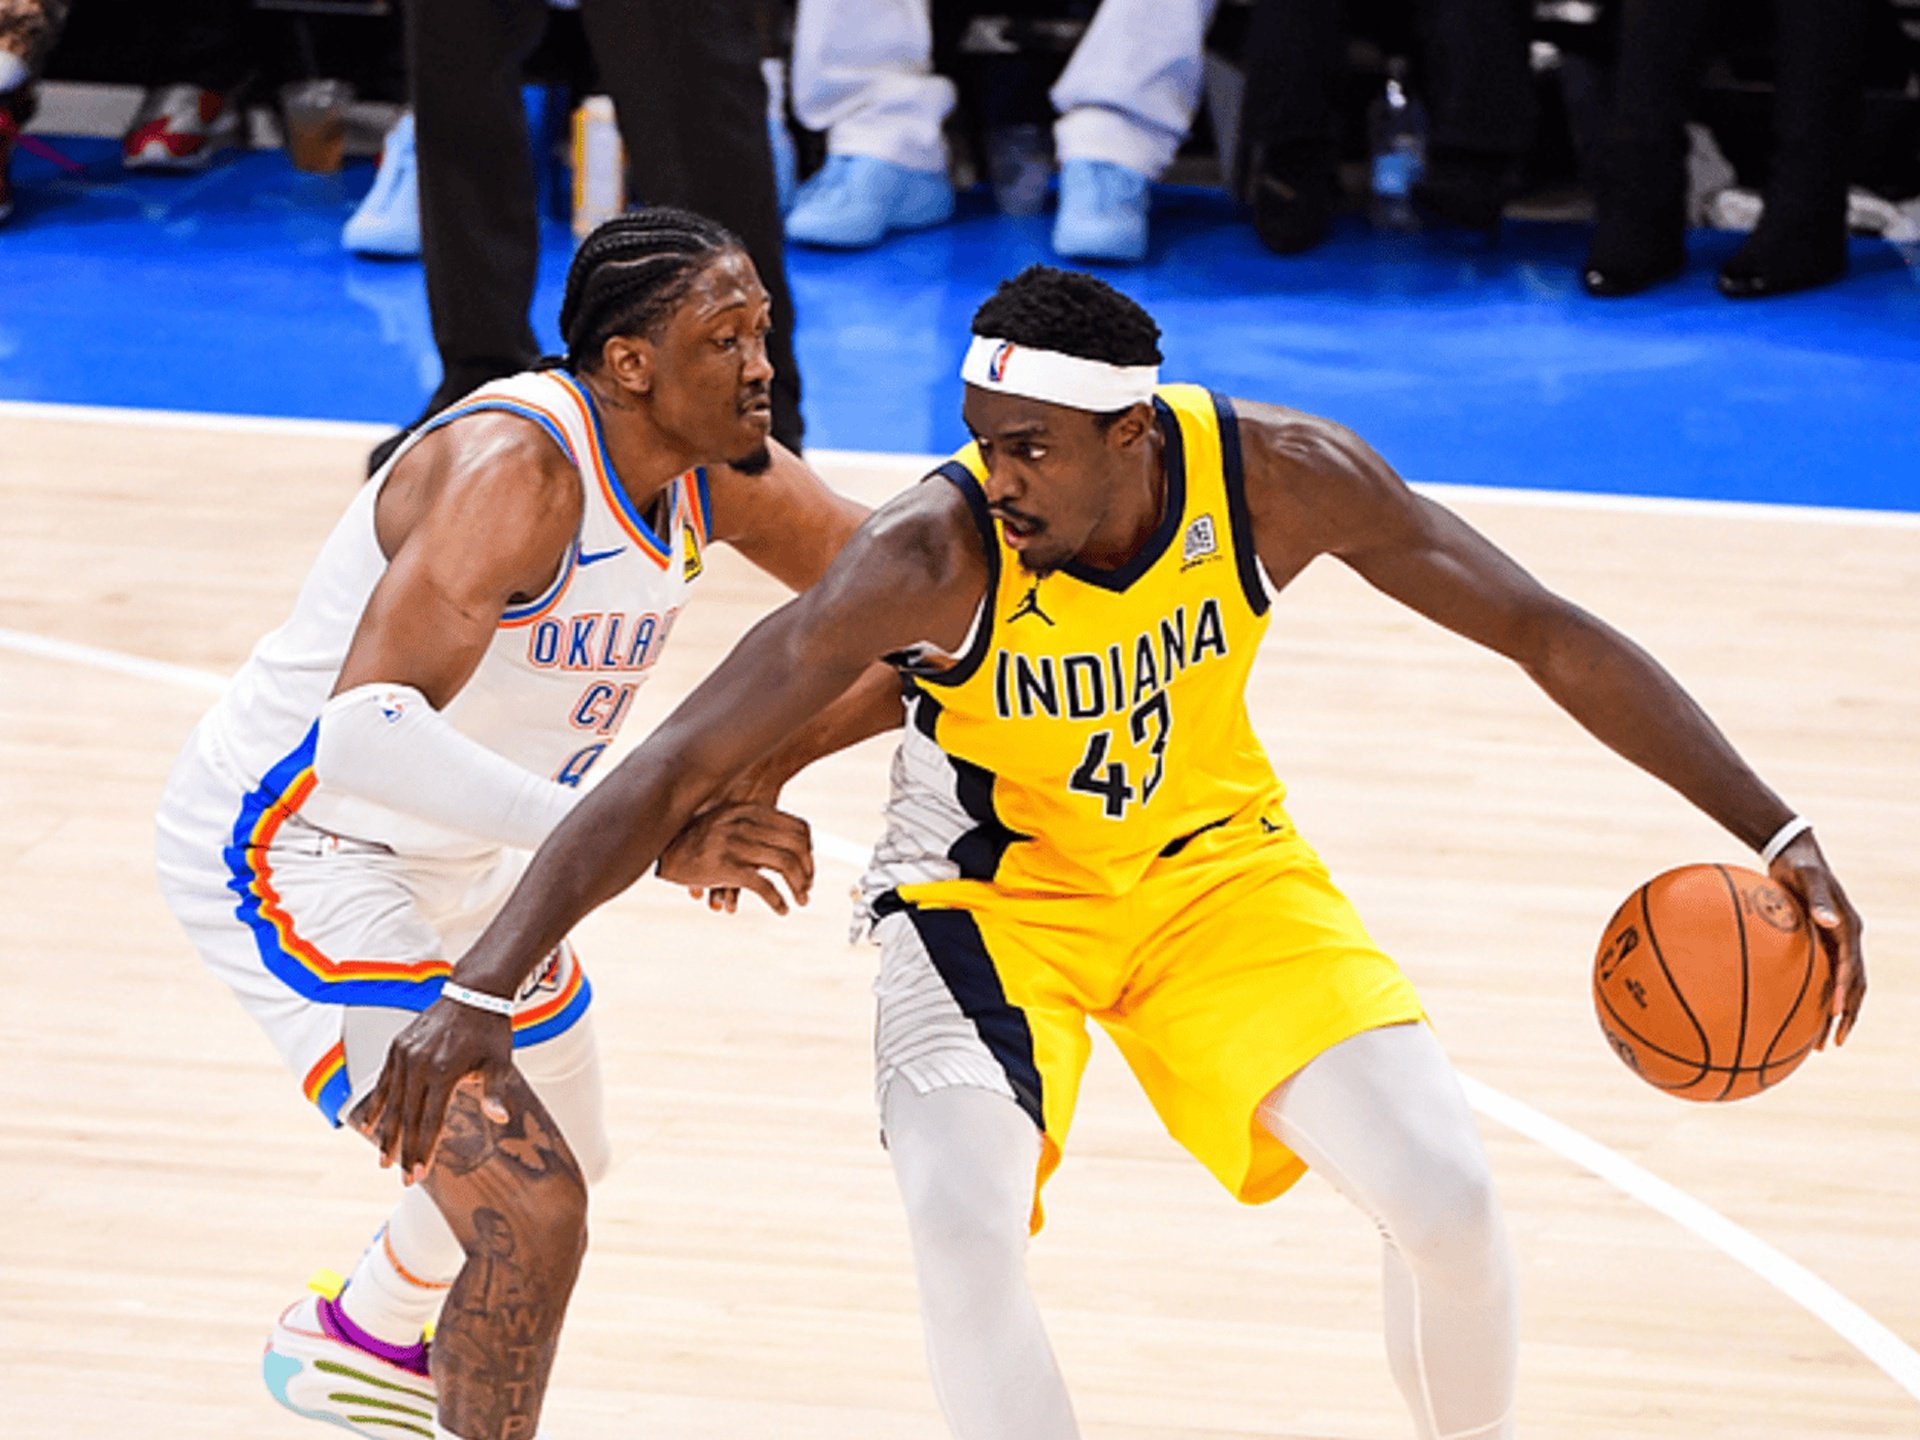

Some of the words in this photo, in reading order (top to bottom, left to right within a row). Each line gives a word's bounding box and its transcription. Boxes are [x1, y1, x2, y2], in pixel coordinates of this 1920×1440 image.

[527, 606, 679, 672] OKLA
[995, 598, 1227, 719] INDIANA
[1067, 688, 1172, 821] 43
